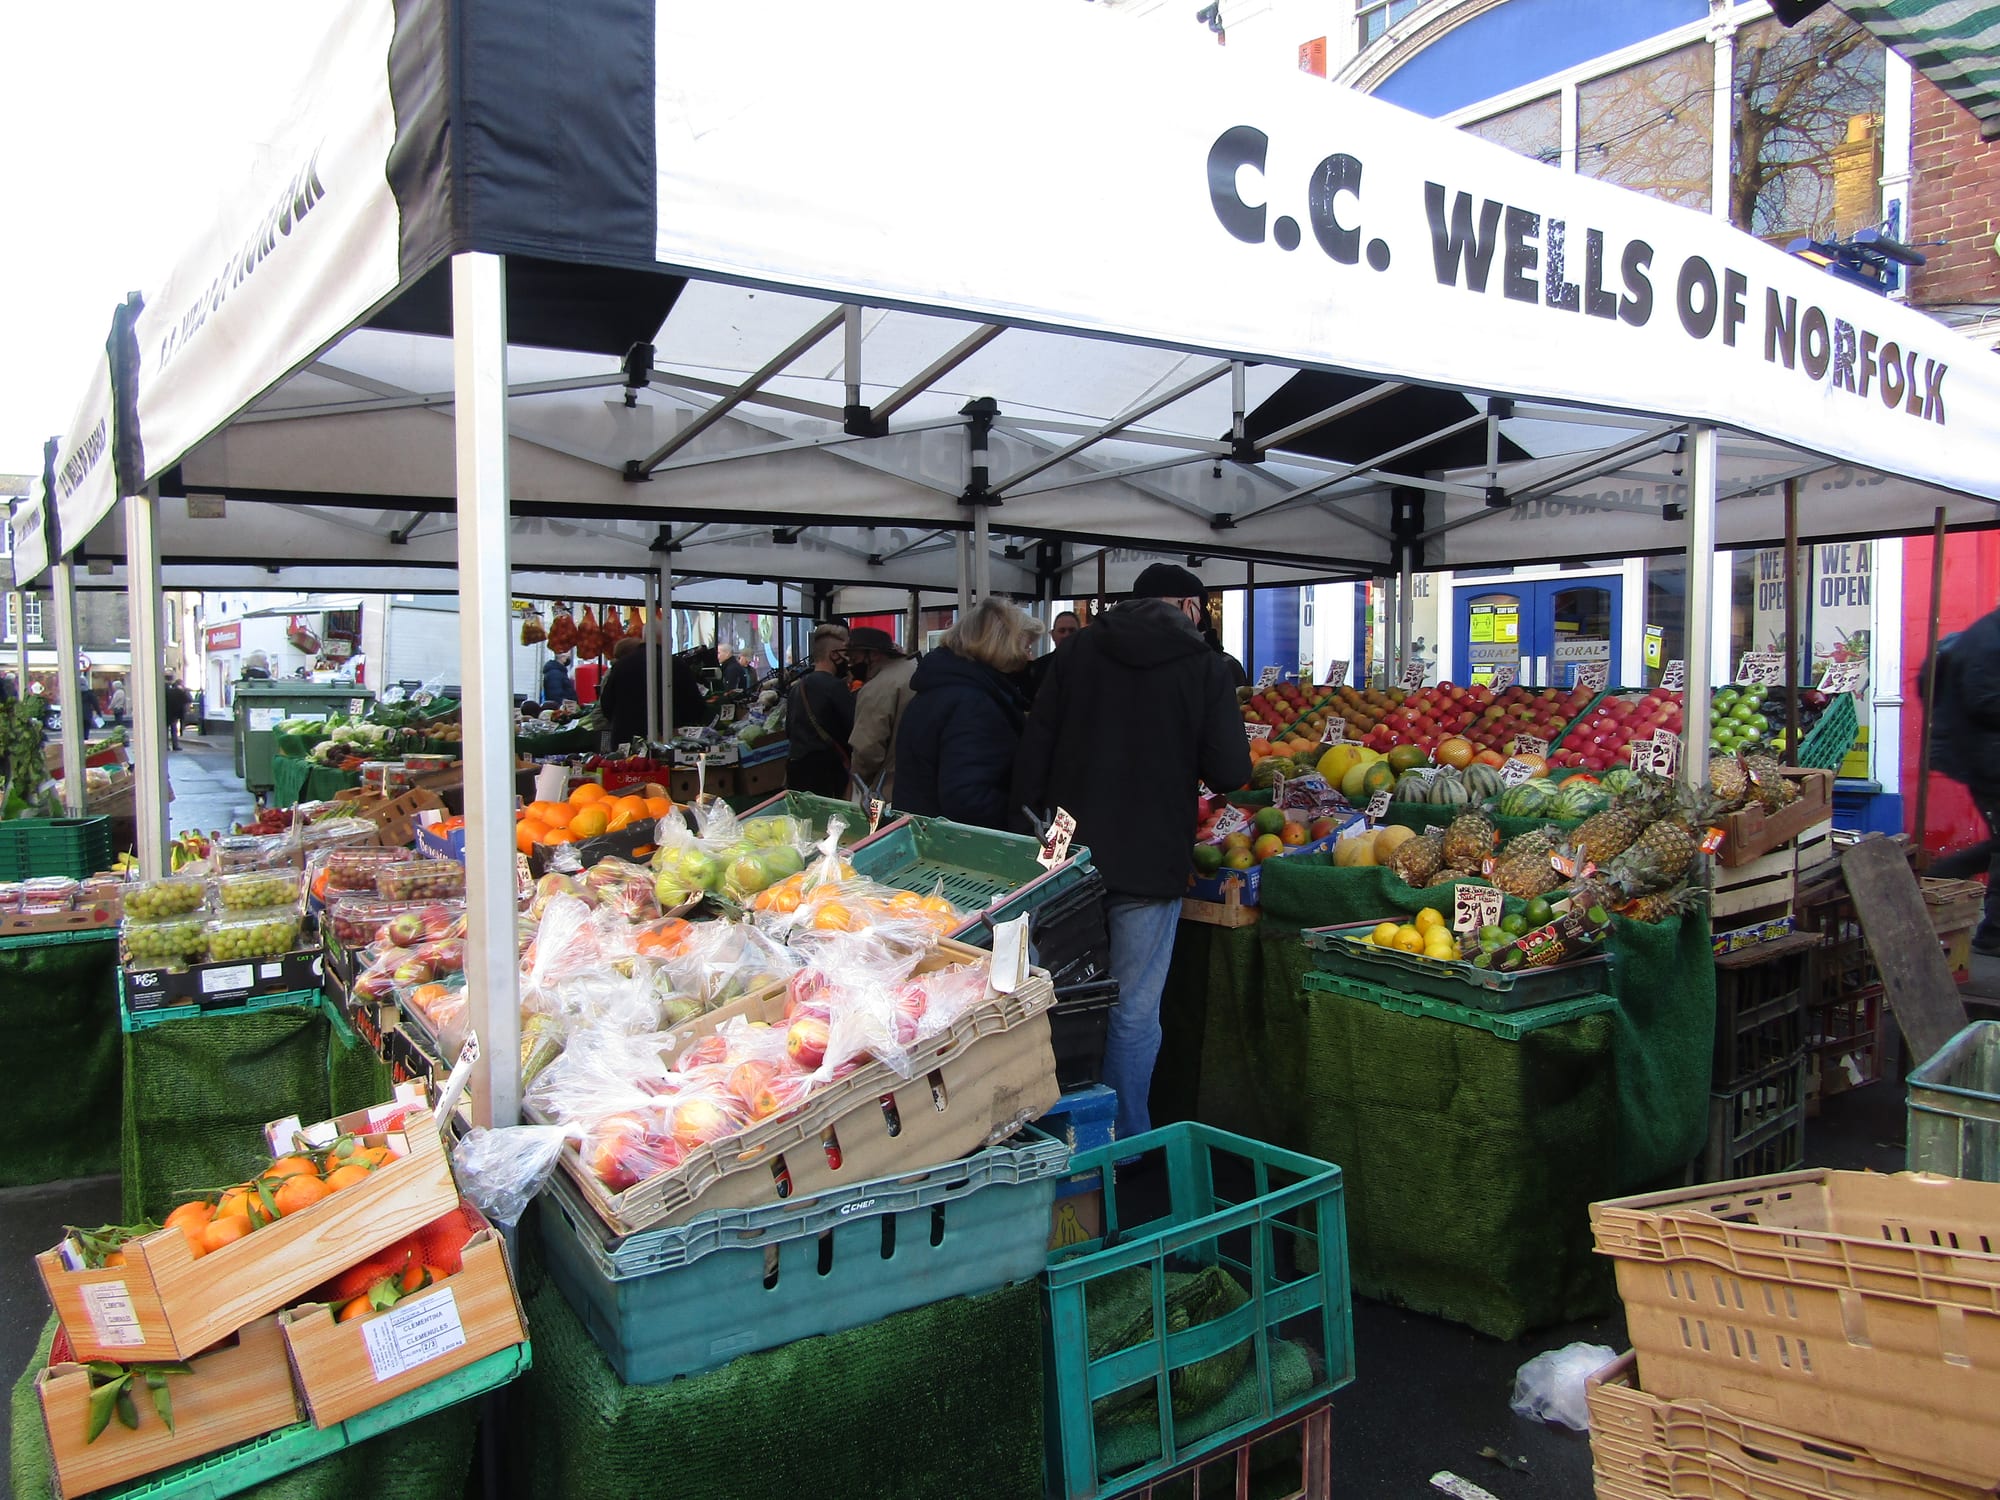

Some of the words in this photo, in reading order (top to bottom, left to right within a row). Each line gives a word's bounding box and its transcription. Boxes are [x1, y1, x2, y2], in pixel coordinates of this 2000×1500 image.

[1206, 125, 1391, 272] C.C.
[1424, 180, 1653, 327] WELLS
[1676, 255, 1748, 347] OF
[1764, 287, 1949, 425] NORFOLK
[1760, 550, 1780, 580] WE
[1820, 544, 1851, 575] WE
[1759, 581, 1785, 611] OPE
[1820, 575, 1871, 608] OPEN
[1470, 648, 1511, 660] CORAL
[1555, 646, 1601, 657] CORAL
[403, 1311, 443, 1332] CLEMENTINA
[406, 1322, 449, 1345] CLEMENULES
